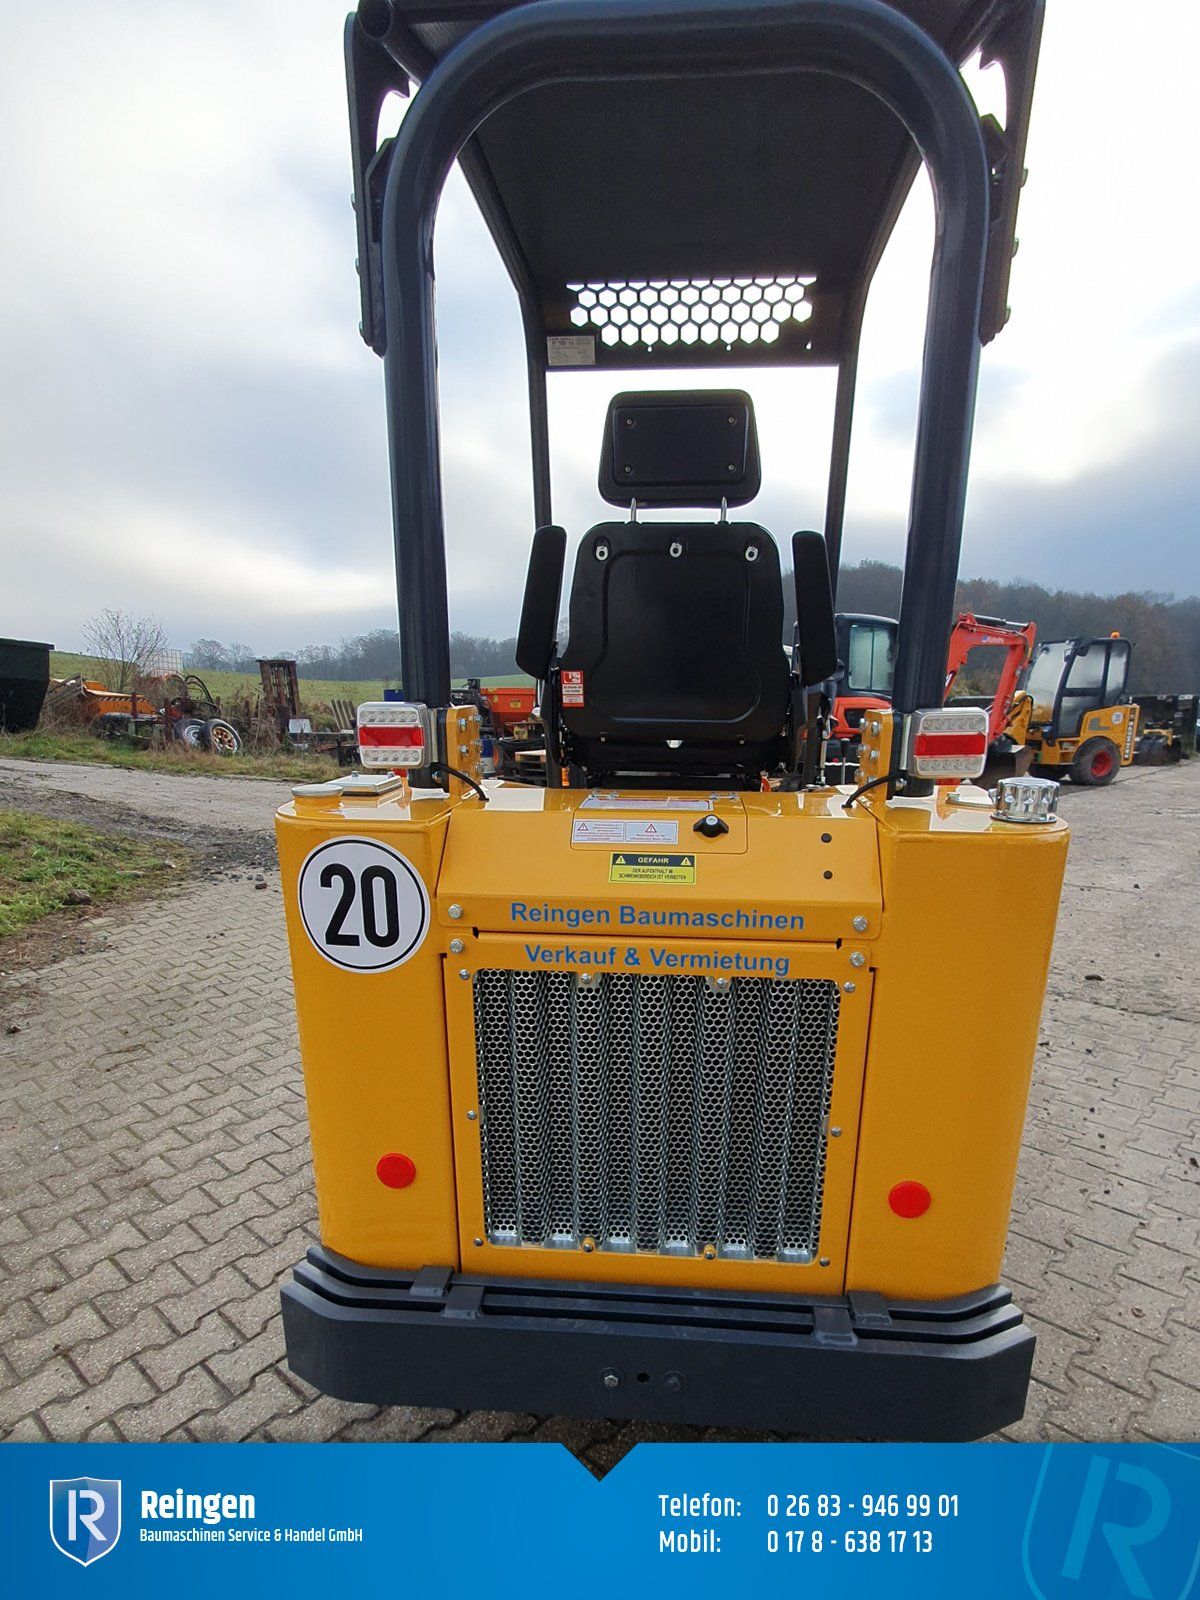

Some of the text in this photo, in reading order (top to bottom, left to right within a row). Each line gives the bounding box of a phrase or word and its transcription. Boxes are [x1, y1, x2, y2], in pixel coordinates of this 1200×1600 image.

[320, 863, 400, 948] 20
[511, 902, 804, 929] Reingen Baumaschinen
[525, 944, 790, 976] Verkauf & Vermietung
